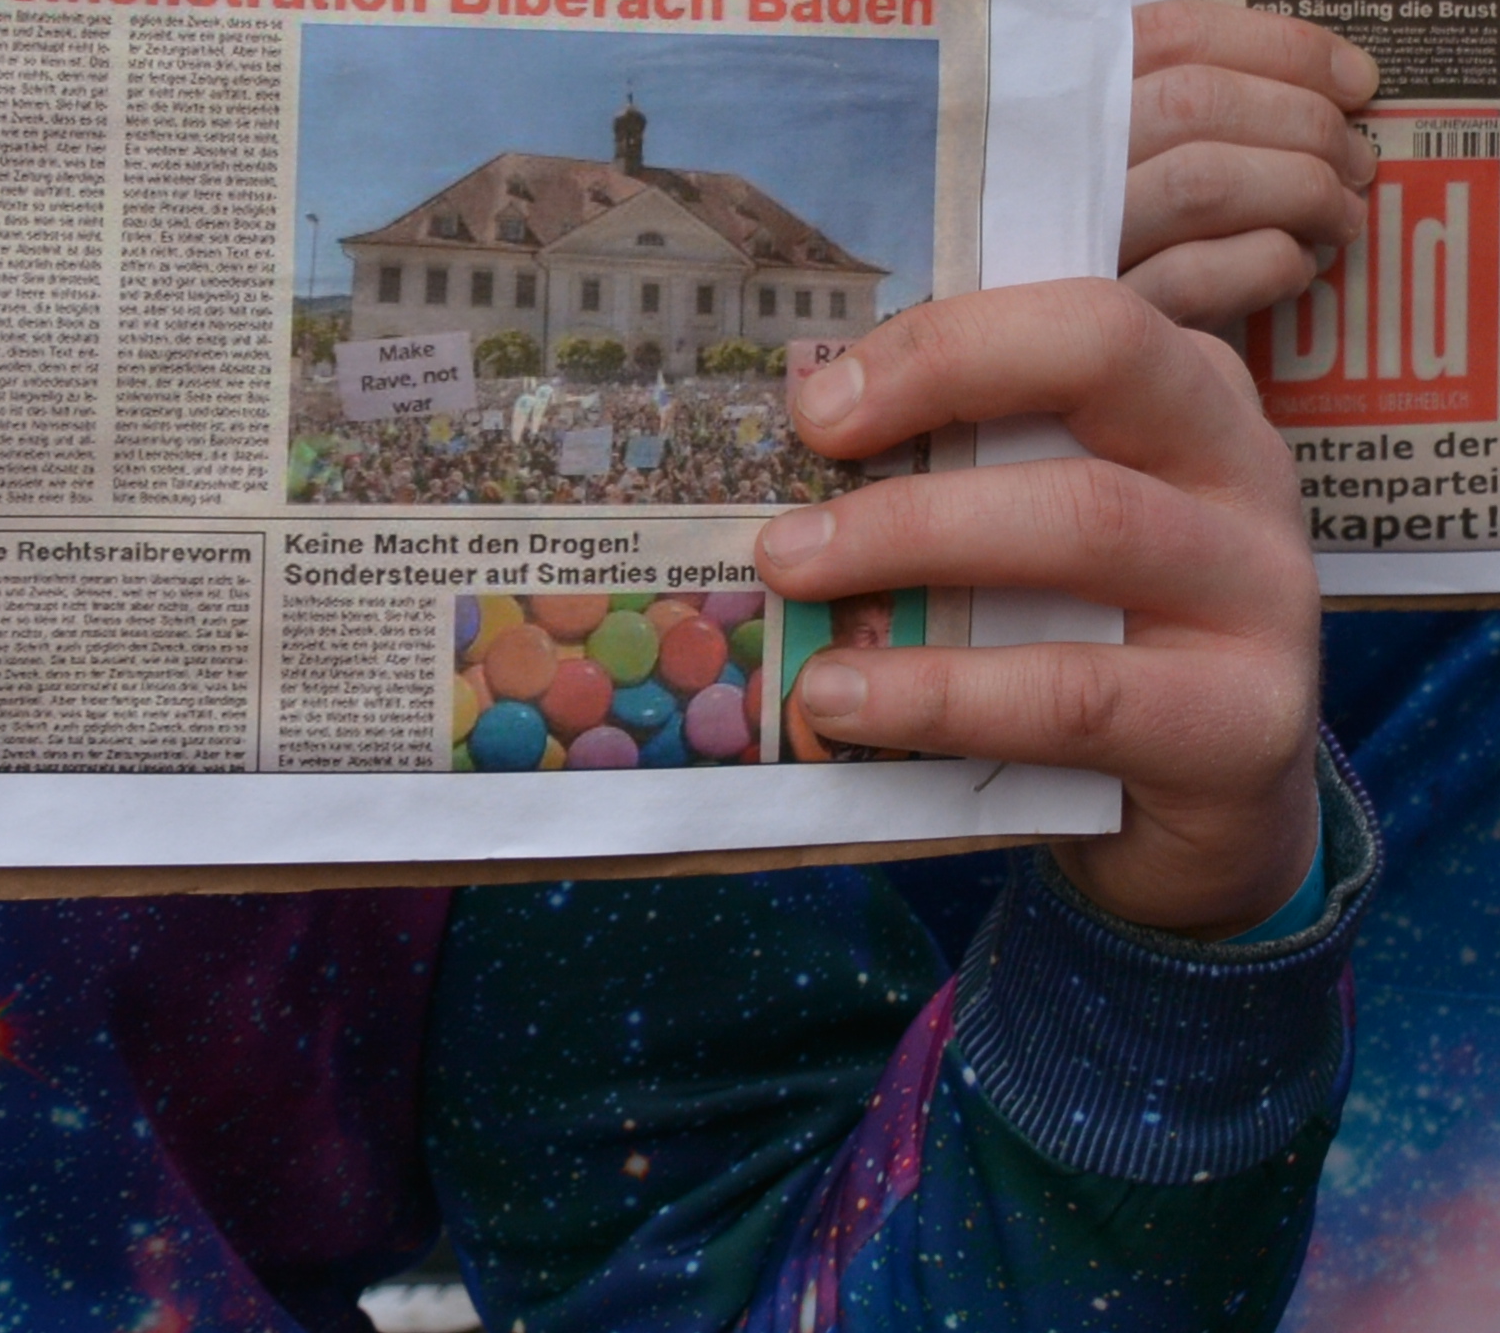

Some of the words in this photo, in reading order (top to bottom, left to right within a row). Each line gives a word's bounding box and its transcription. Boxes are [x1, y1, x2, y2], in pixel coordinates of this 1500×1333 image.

[1299, 0, 1393, 21] Säugling
[1400, 1, 1432, 17] die
[1439, 2, 1496, 17] Brust
[1415, 119, 1498, 130] ONLINEWAHN
[379, 342, 435, 363] Make
[361, 375, 417, 391] Rave,
[423, 366, 458, 384] not
[393, 397, 432, 414] war
[1295, 434, 1414, 462] ntrale
[1435, 433, 1498, 458] der
[1301, 468, 1498, 503] atenpartei
[1310, 506, 1498, 547] kapert!
[18, 542, 251, 563] Rechtsraibrevorm
[285, 533, 363, 553] Keine
[375, 534, 458, 553] Macht
[469, 534, 518, 553] den
[530, 532, 639, 560] Drogen!
[285, 564, 477, 585] Sondersteuer
[486, 563, 528, 584] auf
[538, 564, 657, 584] Smarties
[667, 561, 760, 588] geplan
